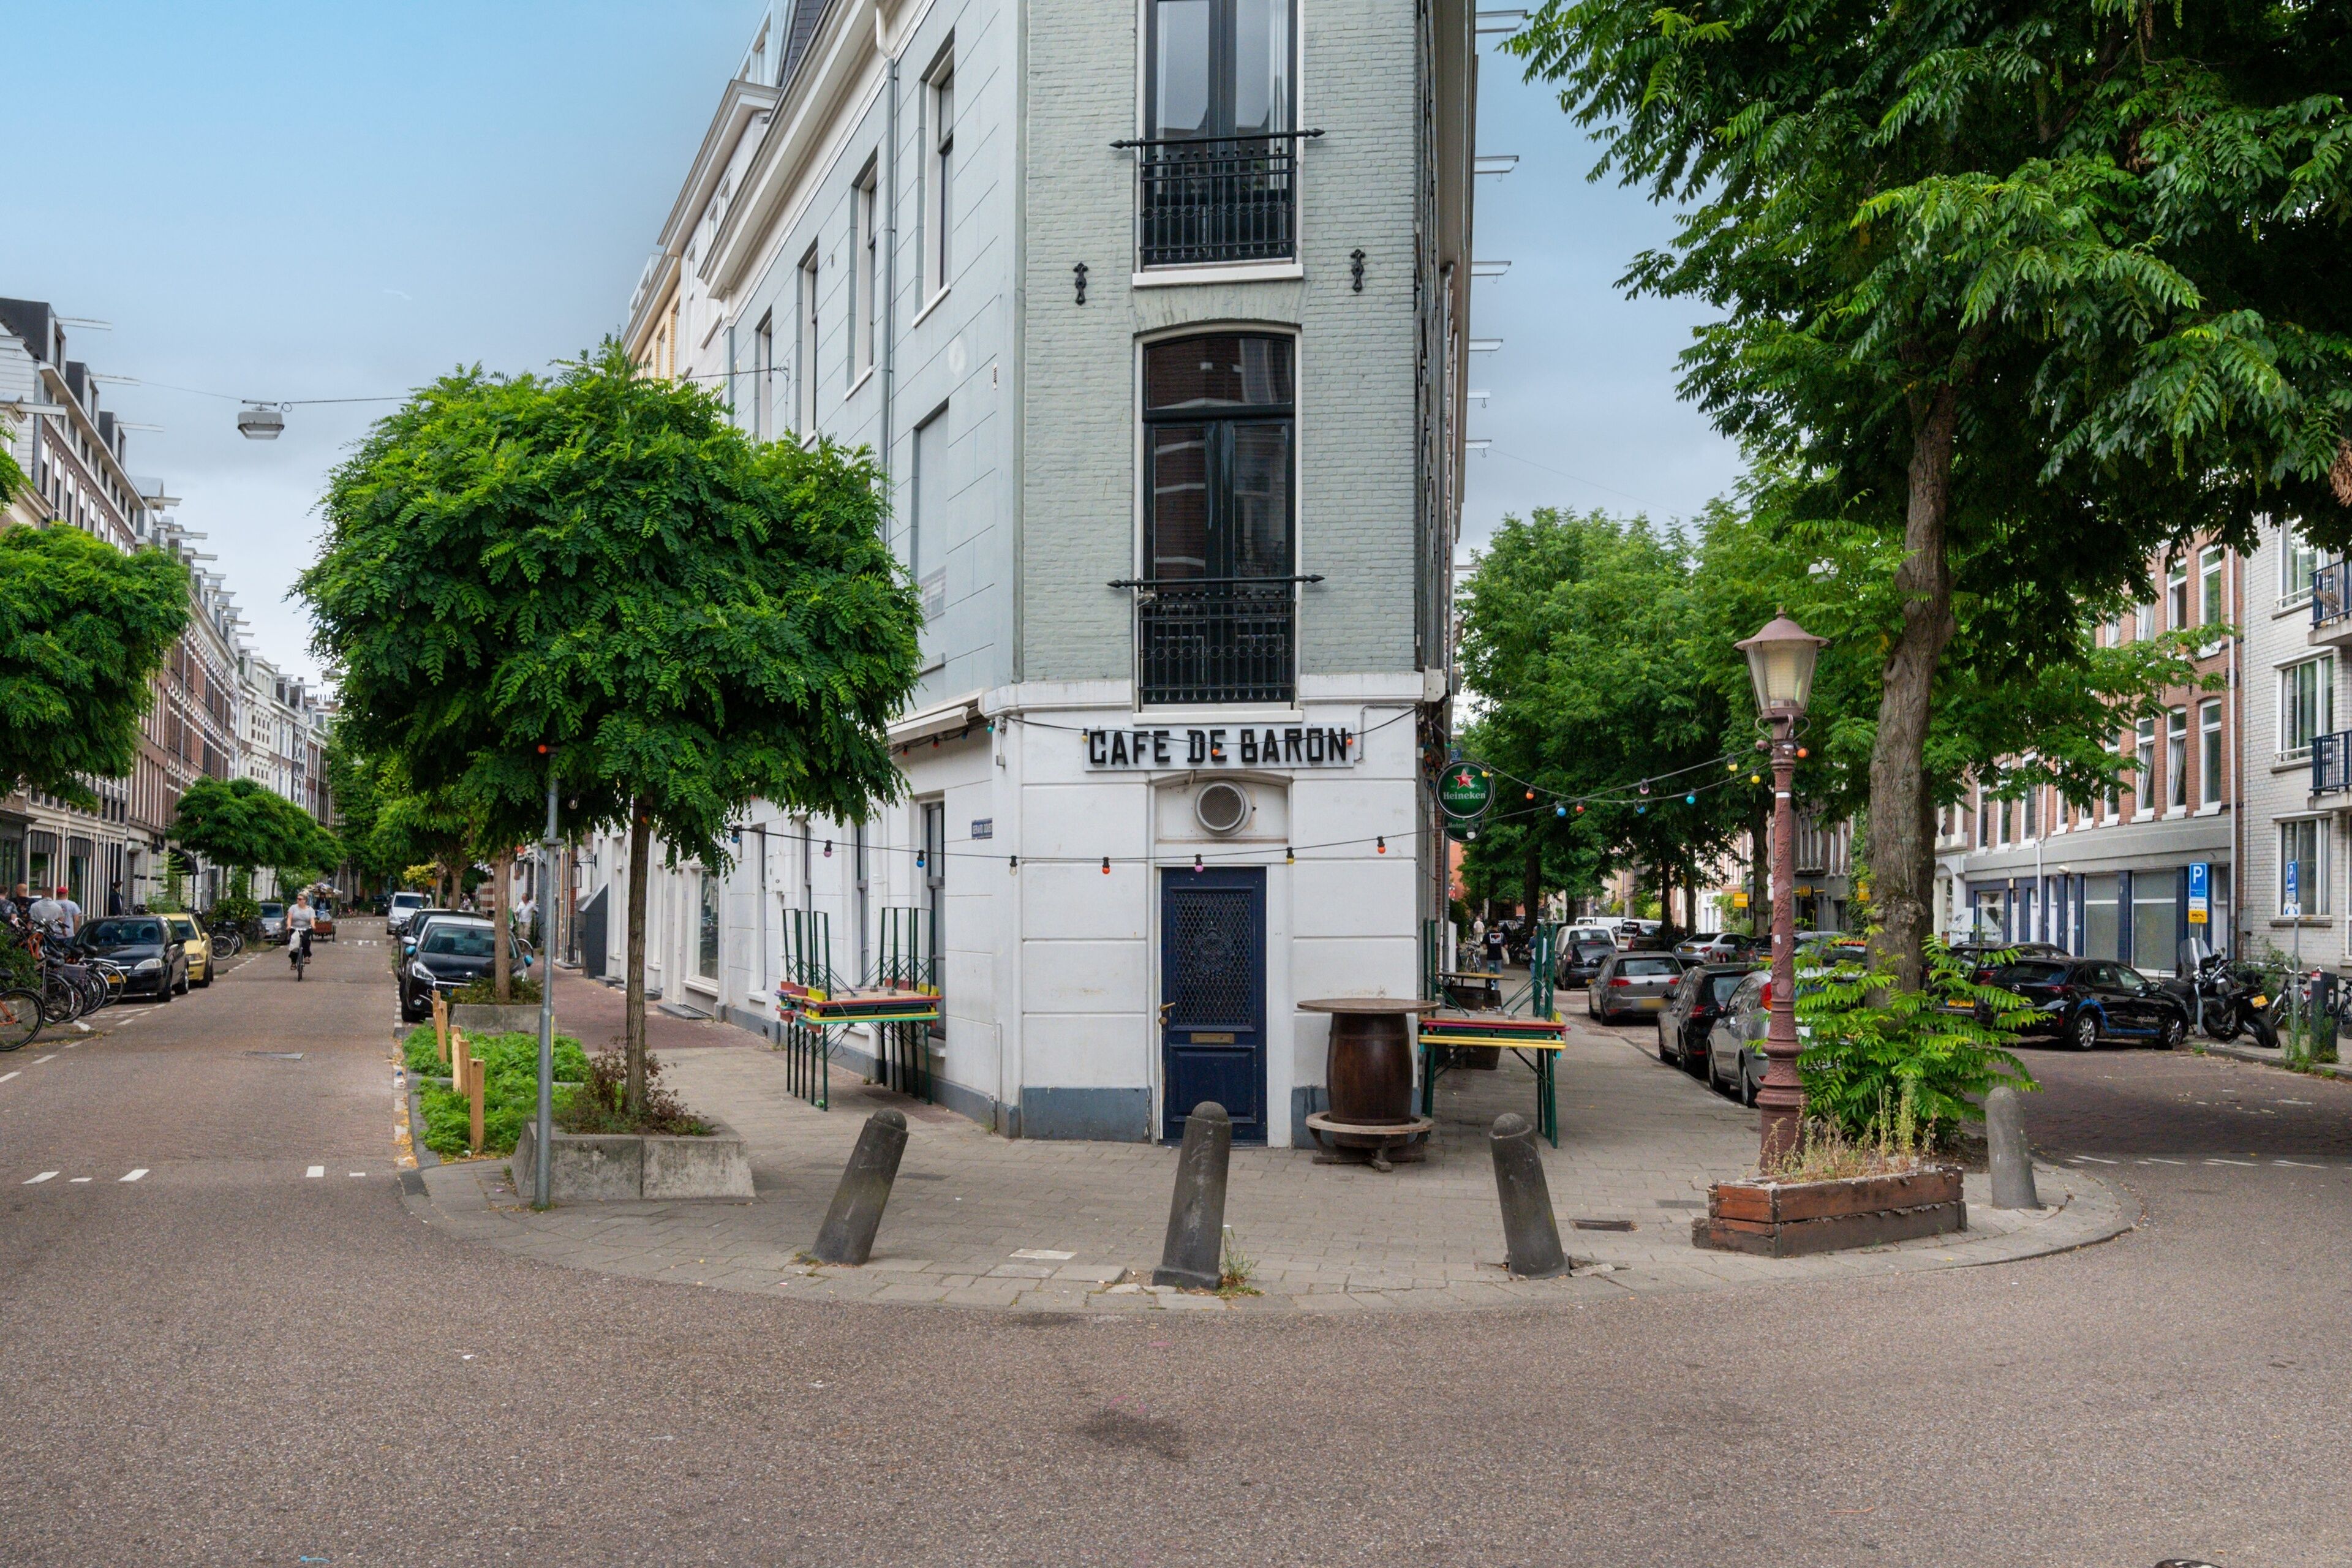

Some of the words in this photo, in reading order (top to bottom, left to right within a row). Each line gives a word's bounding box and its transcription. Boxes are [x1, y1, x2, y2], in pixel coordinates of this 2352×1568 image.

[1088, 730, 1171, 765] CAFE
[1186, 729, 1227, 763] DE
[1240, 727, 1347, 763] BARON
[1443, 791, 1486, 800] Heineken
